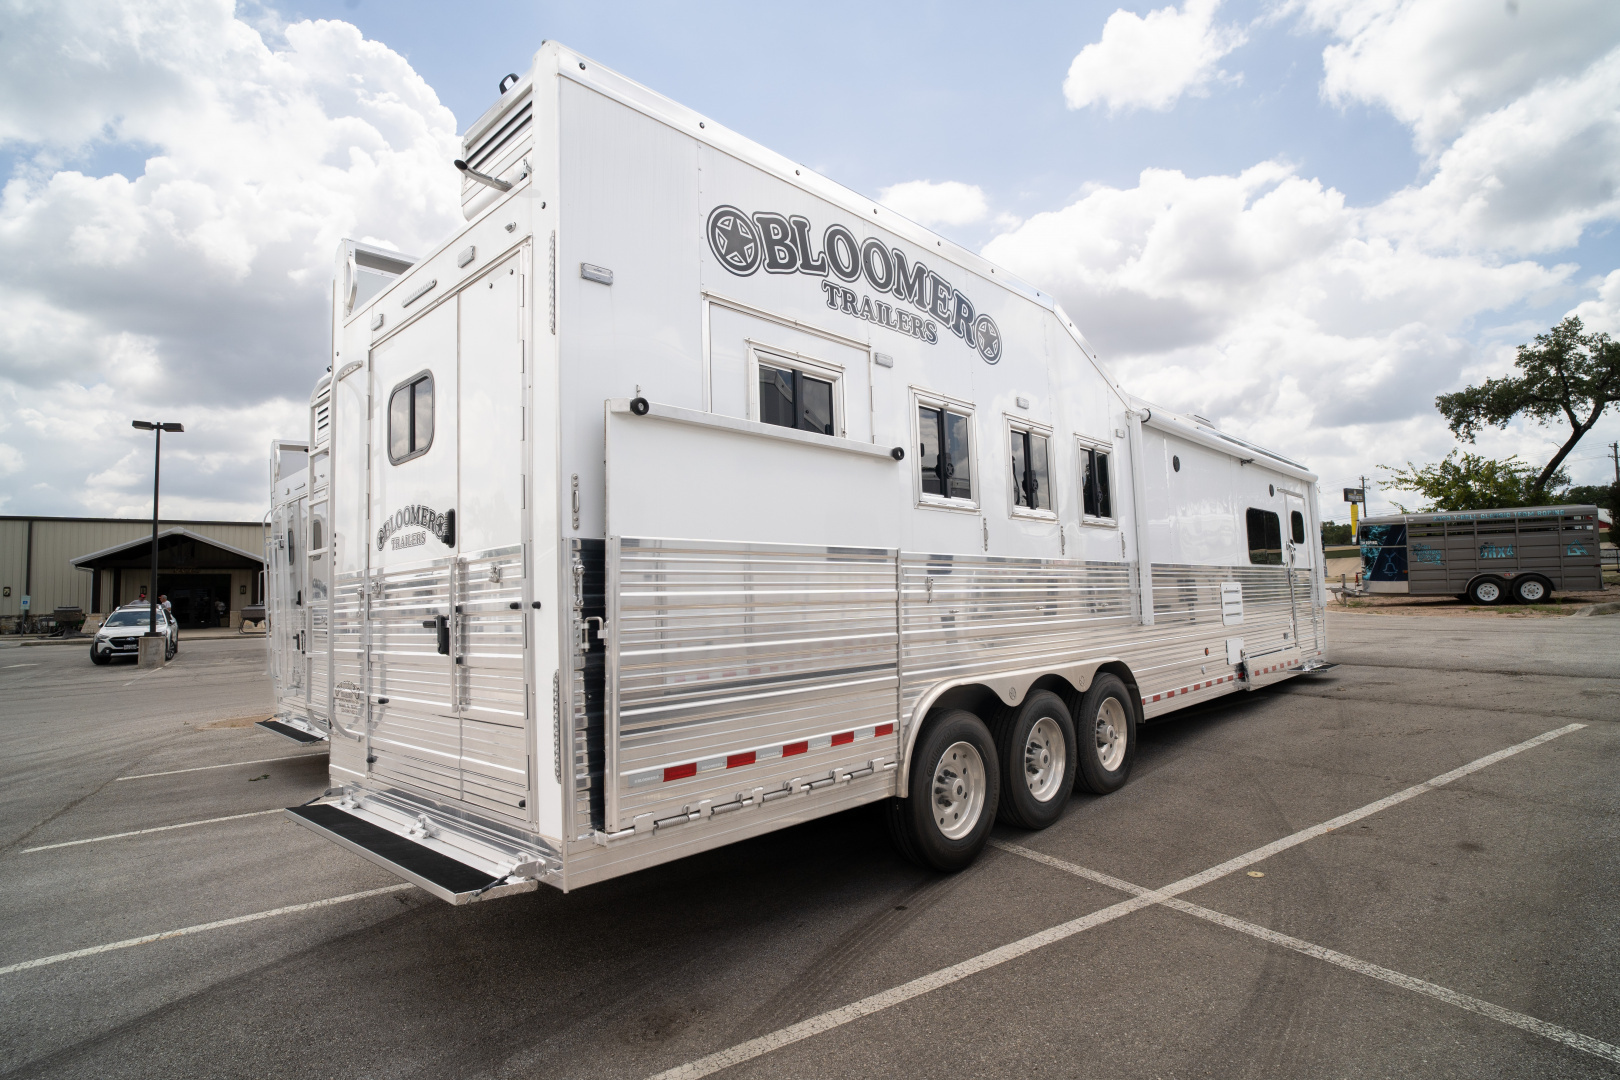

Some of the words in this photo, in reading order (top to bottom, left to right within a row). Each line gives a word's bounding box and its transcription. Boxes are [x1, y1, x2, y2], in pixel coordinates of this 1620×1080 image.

[752, 211, 977, 349] BLOOMER
[822, 280, 938, 345] TRAILERS
[383, 504, 436, 542] BLOOMER
[391, 530, 426, 550] TRAILERS
